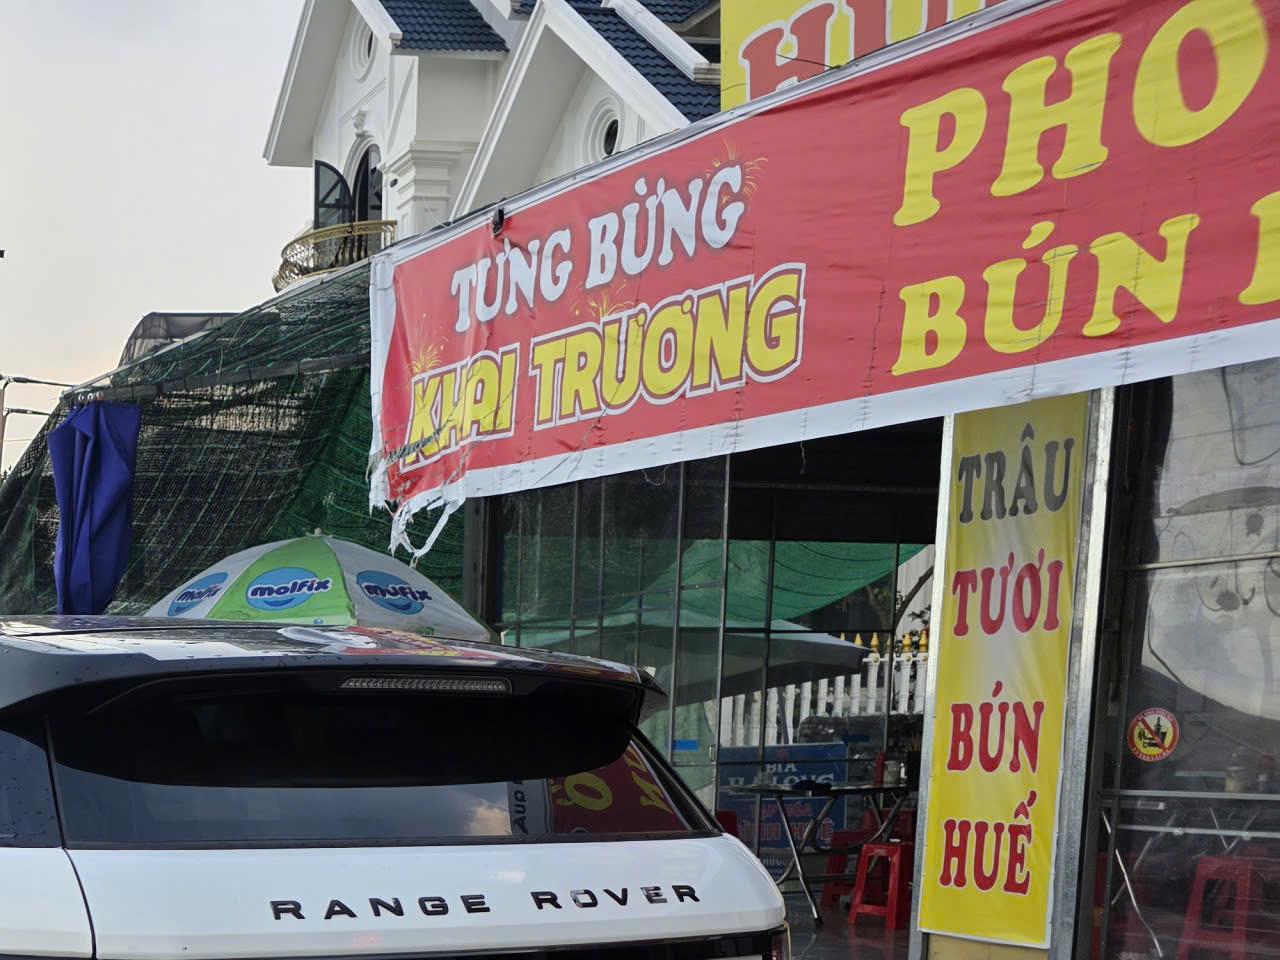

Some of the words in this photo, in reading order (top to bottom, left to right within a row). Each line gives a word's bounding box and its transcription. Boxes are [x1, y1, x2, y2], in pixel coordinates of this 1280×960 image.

[451, 229, 572, 333] TƯNG
[585, 164, 745, 290] BỪNG
[892, 213, 1201, 376] BÚN
[403, 345, 520, 467] KHAI
[531, 266, 804, 428] TRƯƠNG
[958, 423, 1074, 523] TRÂU
[250, 578, 331, 598] molfix
[952, 548, 1063, 636] TƯƠI
[947, 680, 1045, 773] BÚN
[940, 790, 1037, 894] HUẾ
[270, 893, 491, 921] RANGE
[529, 884, 701, 911] ROVER
